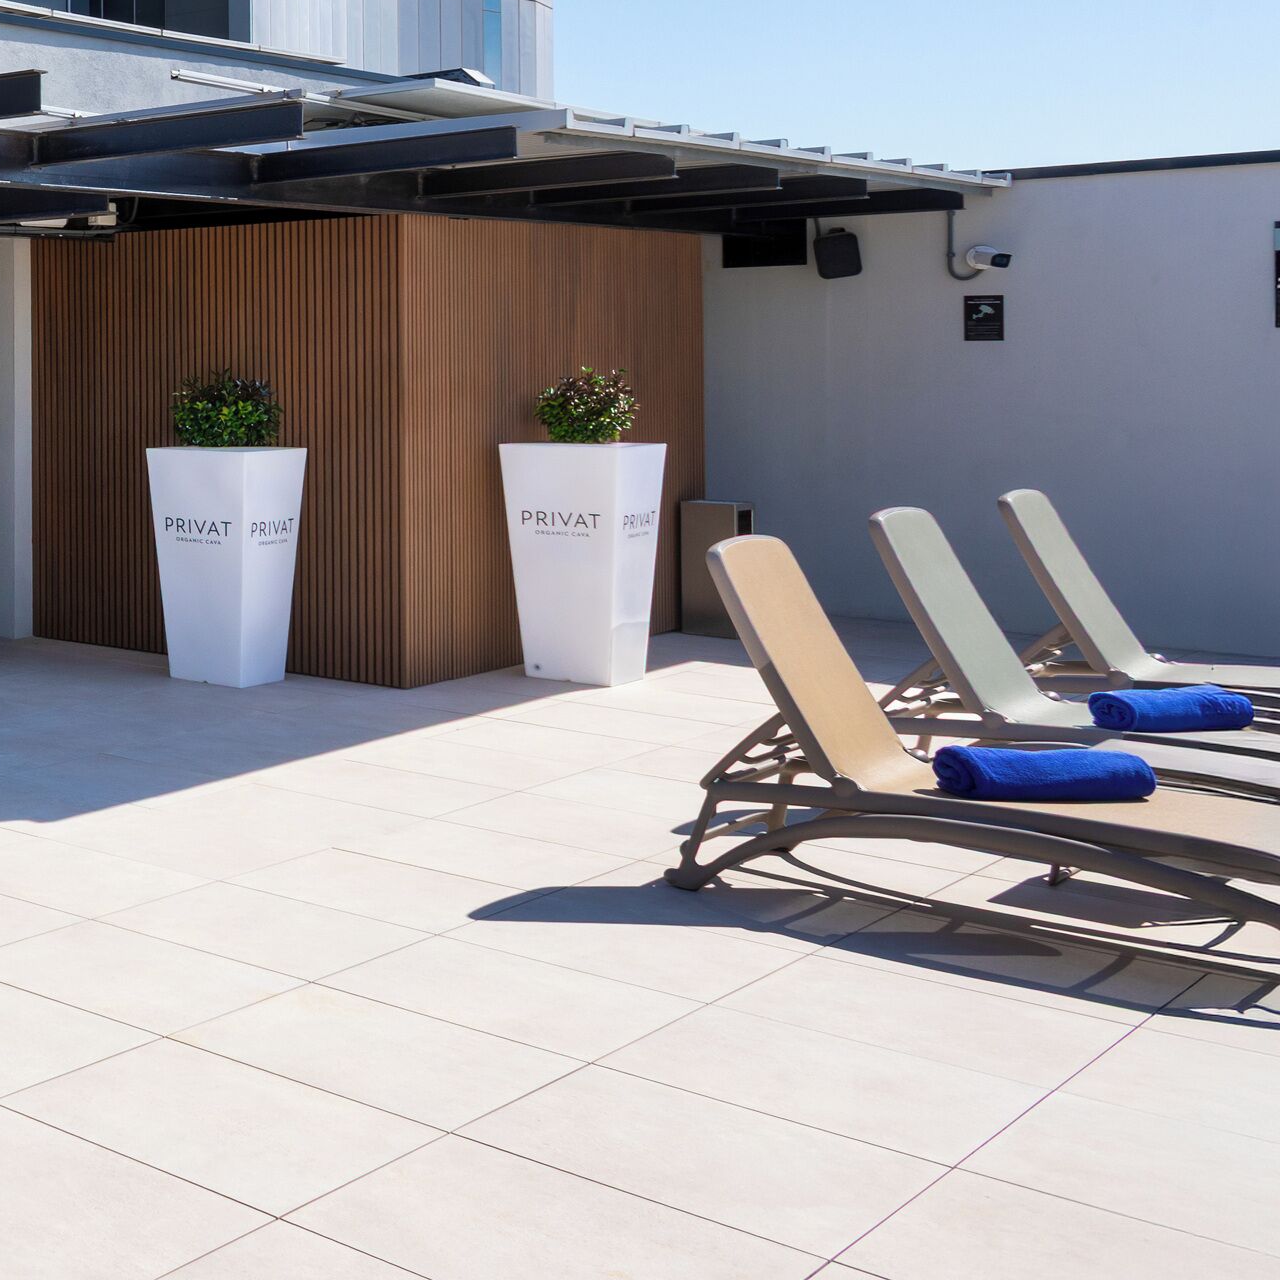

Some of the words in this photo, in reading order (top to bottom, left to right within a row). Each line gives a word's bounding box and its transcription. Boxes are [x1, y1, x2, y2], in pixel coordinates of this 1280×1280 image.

[164, 516, 233, 537] PRIVAT
[250, 518, 295, 538] PRIVAT
[521, 510, 601, 529] PRIVAT
[622, 510, 657, 531] PRIVAT
[175, 536, 204, 544] ORGANIC
